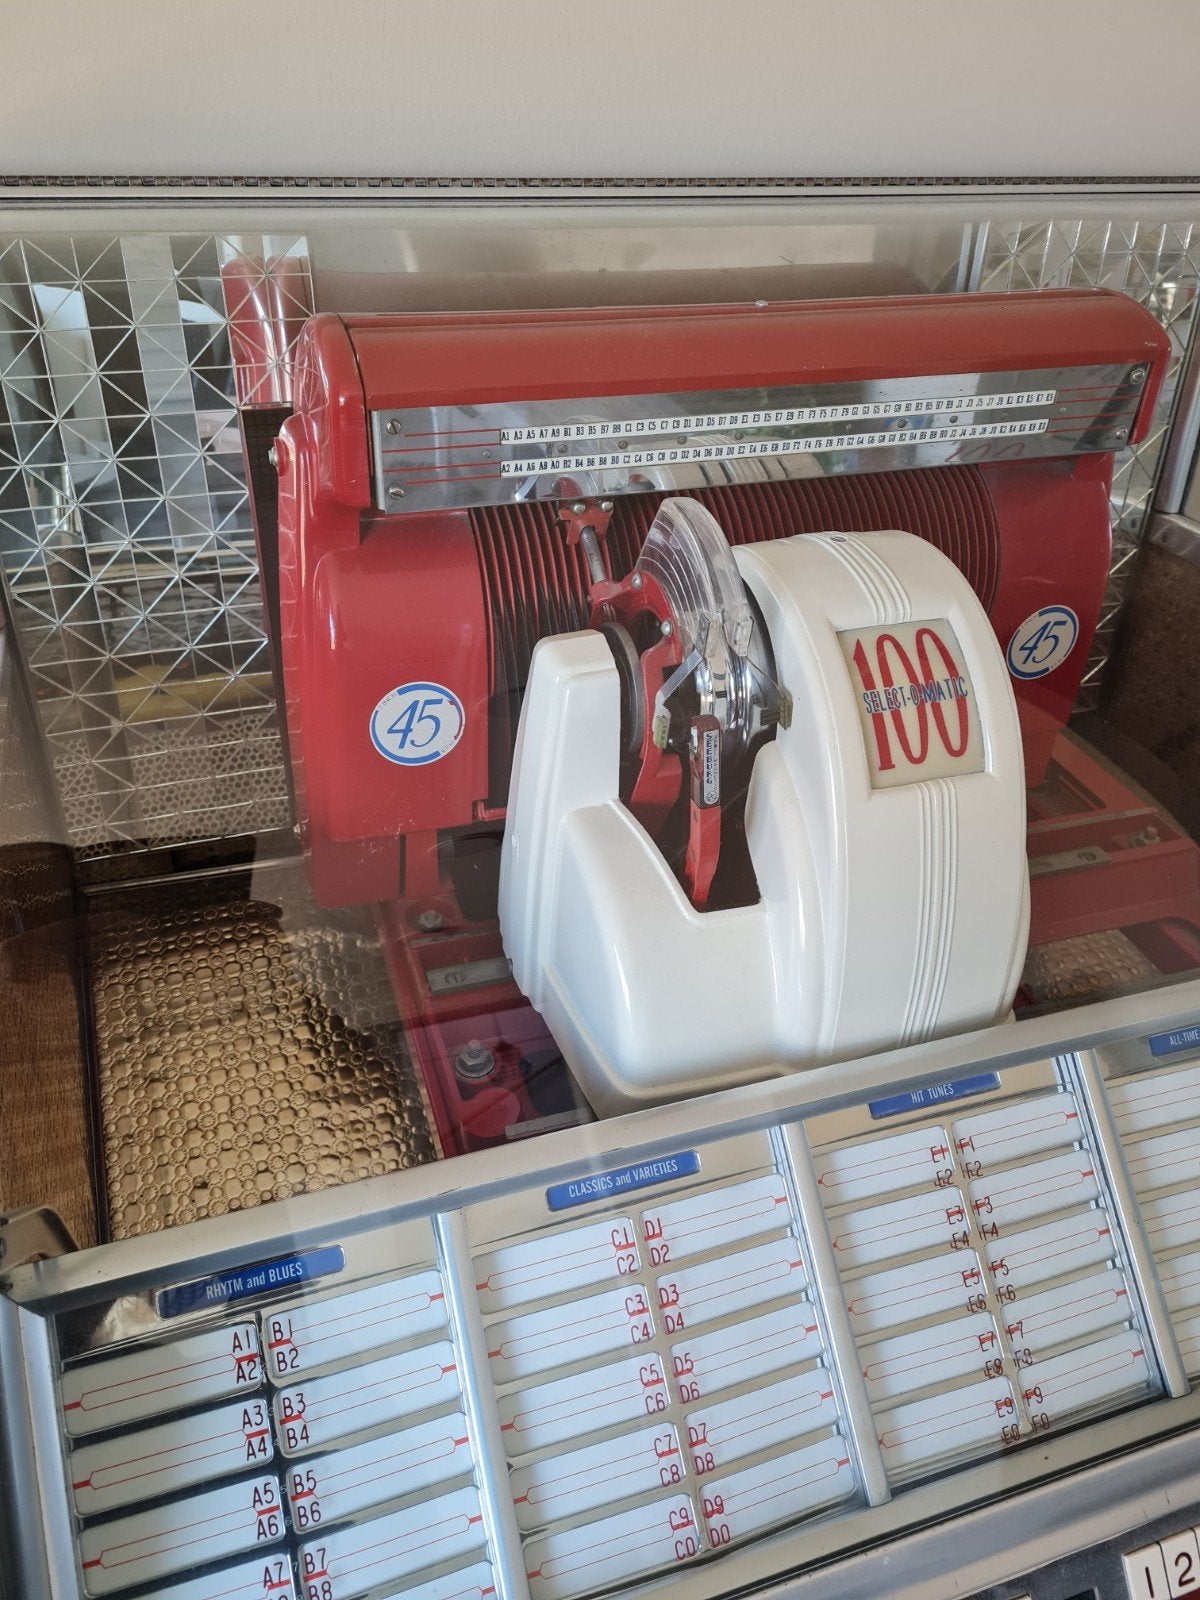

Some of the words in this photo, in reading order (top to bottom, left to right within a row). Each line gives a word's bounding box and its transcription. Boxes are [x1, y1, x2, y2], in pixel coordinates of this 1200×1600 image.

[501, 430, 509, 441] A1
[513, 429, 522, 440] A3
[526, 429, 535, 439] A5
[539, 428, 548, 438] A7
[550, 427, 560, 437] A9
[563, 426, 571, 437] B1
[575, 425, 584, 436] B3
[587, 424, 596, 435] B5
[600, 423, 609, 434] B7
[612, 423, 621, 433] B9
[624, 422, 632, 432] C1
[635, 421, 644, 431] C3
[647, 420, 656, 431] C5
[660, 419, 668, 430] C7
[671, 418, 680, 429] C9
[501, 463, 510, 473] A2
[514, 462, 522, 472] A4
[526, 461, 535, 471] A6
[538, 460, 547, 470] A8
[550, 459, 559, 469] A0
[562, 458, 571, 469] B2
[574, 457, 583, 468] B4
[586, 456, 595, 467] B6
[598, 455, 607, 466] B8
[610, 454, 619, 465] B0
[622, 453, 630, 464] C2
[634, 453, 642, 463] C4
[645, 452, 654, 462] C6
[1019, 621, 1067, 664] 45
[853, 628, 969, 771] 100
[862, 676, 968, 714] SELECT-O-MATIC
[387, 699, 443, 749] 45
[1169, 1029, 1199, 1046] ALL-TIME
[910, 1091, 924, 1104] HIT
[928, 1084, 954, 1100] TUNES
[568, 1176, 613, 1198] CLASSICS
[615, 1171, 631, 1186] and
[633, 1159, 678, 1180] VARIETIES
[611, 1226, 629, 1248] C1
[645, 1218, 662, 1238] D1
[617, 1254, 638, 1275] C2
[650, 1244, 671, 1268] D2
[206, 1278, 244, 1299] RHYTM
[246, 1272, 266, 1288] and
[269, 1262, 303, 1283] BLUES
[625, 1294, 645, 1316] C3
[659, 1284, 679, 1306] D3
[272, 1319, 293, 1342] B1
[630, 1322, 650, 1344] C4
[664, 1312, 685, 1335] D4
[232, 1330, 250, 1353] A1
[276, 1348, 300, 1372] B2
[673, 1353, 694, 1374] D5
[237, 1360, 258, 1384] A2
[640, 1364, 659, 1386] C5
[645, 1392, 666, 1415] C6
[679, 1382, 700, 1404] D6
[282, 1393, 306, 1418] B3
[242, 1405, 264, 1430] A3
[287, 1424, 310, 1449] B4
[688, 1423, 707, 1444] D7
[247, 1436, 267, 1461] A4
[654, 1434, 672, 1457] C7
[660, 1464, 680, 1487] C8
[695, 1452, 715, 1476] D8
[293, 1470, 317, 1495] B5
[252, 1482, 274, 1508] A5
[703, 1495, 724, 1518] D9
[298, 1501, 321, 1527] B6
[669, 1507, 689, 1530] C9
[257, 1515, 279, 1540] A6
[710, 1524, 730, 1548] D0
[675, 1536, 696, 1560] C0
[304, 1548, 327, 1574] B7
[264, 1562, 283, 1588] A7
[1145, 1566, 1154, 1599] 1
[1174, 1552, 1195, 1587] 2
[308, 1581, 332, 1600] B8
